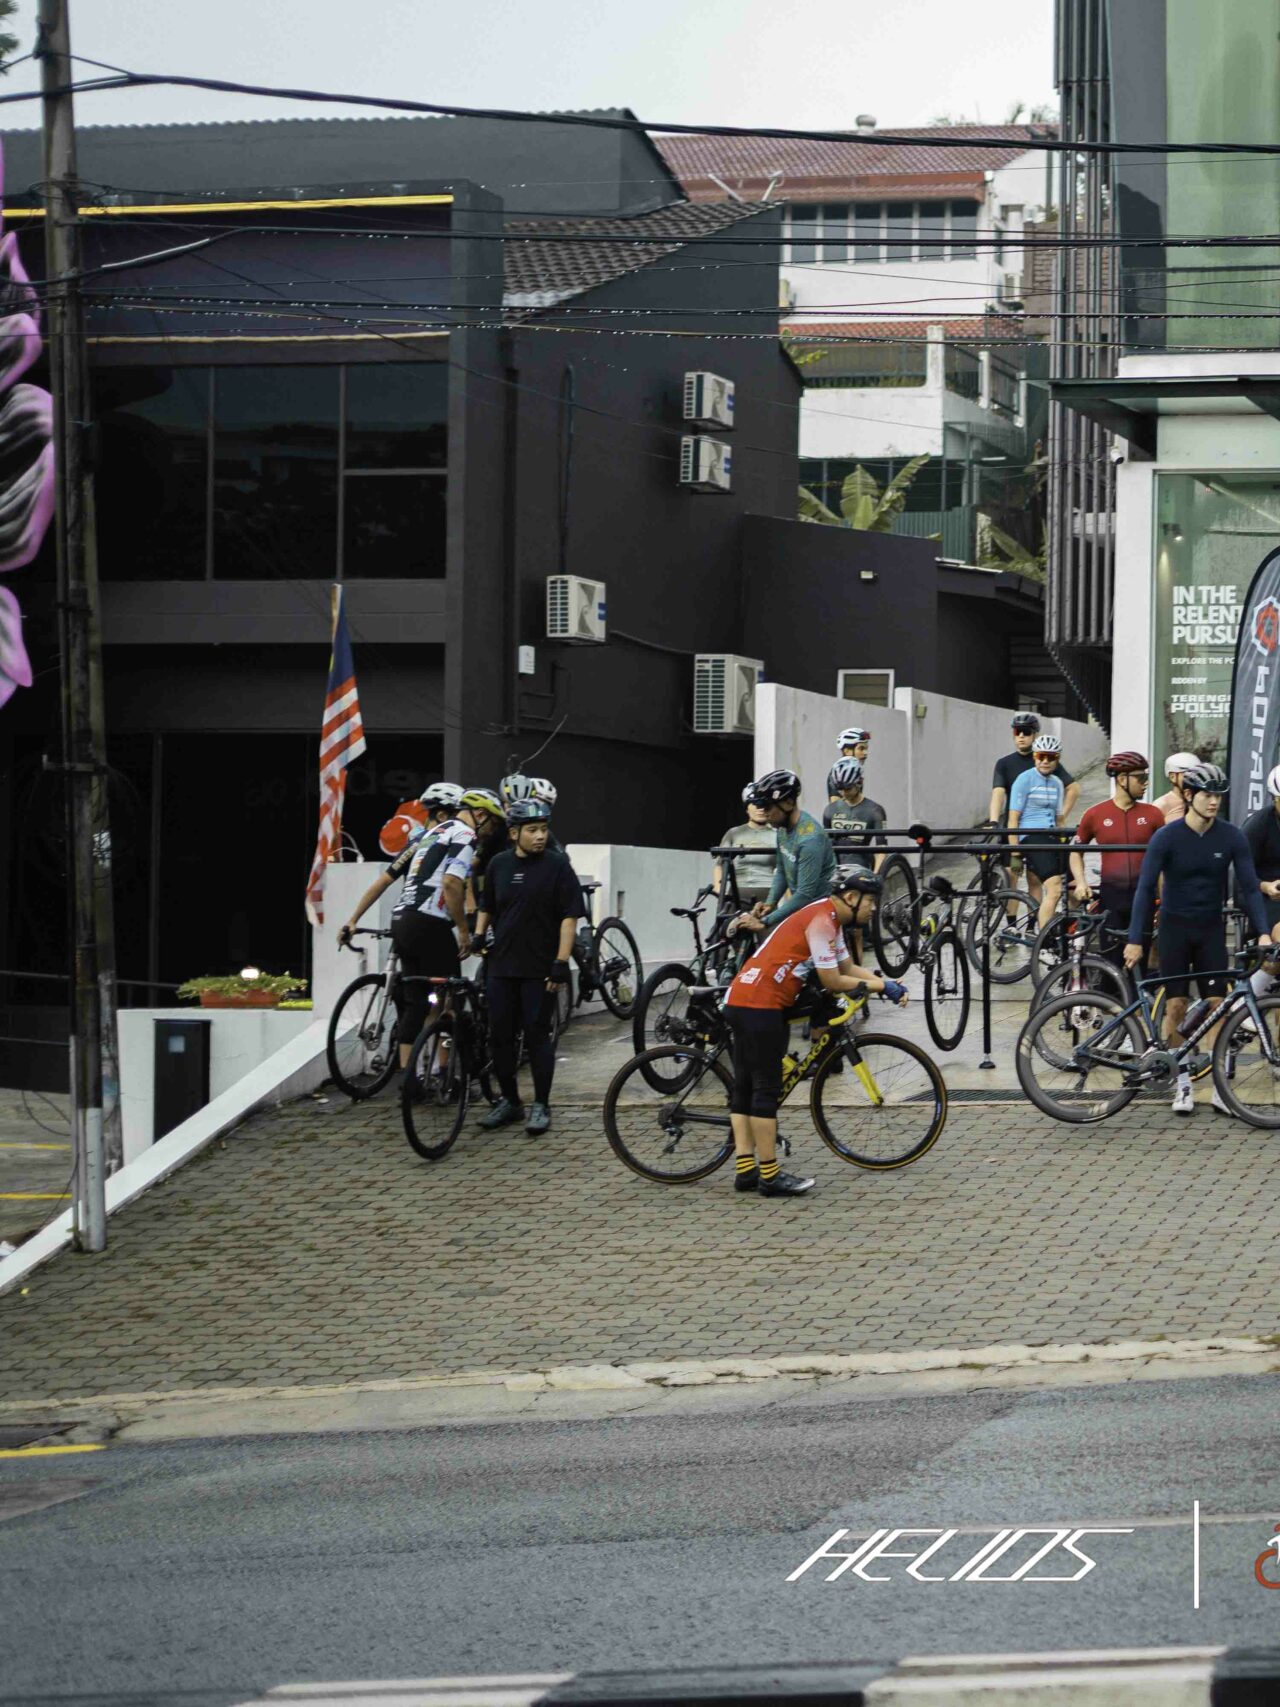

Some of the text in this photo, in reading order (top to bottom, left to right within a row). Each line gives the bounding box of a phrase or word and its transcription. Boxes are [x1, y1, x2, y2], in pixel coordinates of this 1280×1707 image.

[1173, 585, 1237, 604] IN THE
[1173, 605, 1245, 624] RELENT
[1173, 625, 1240, 645] PURSU
[1247, 666, 1271, 814] POLYG
